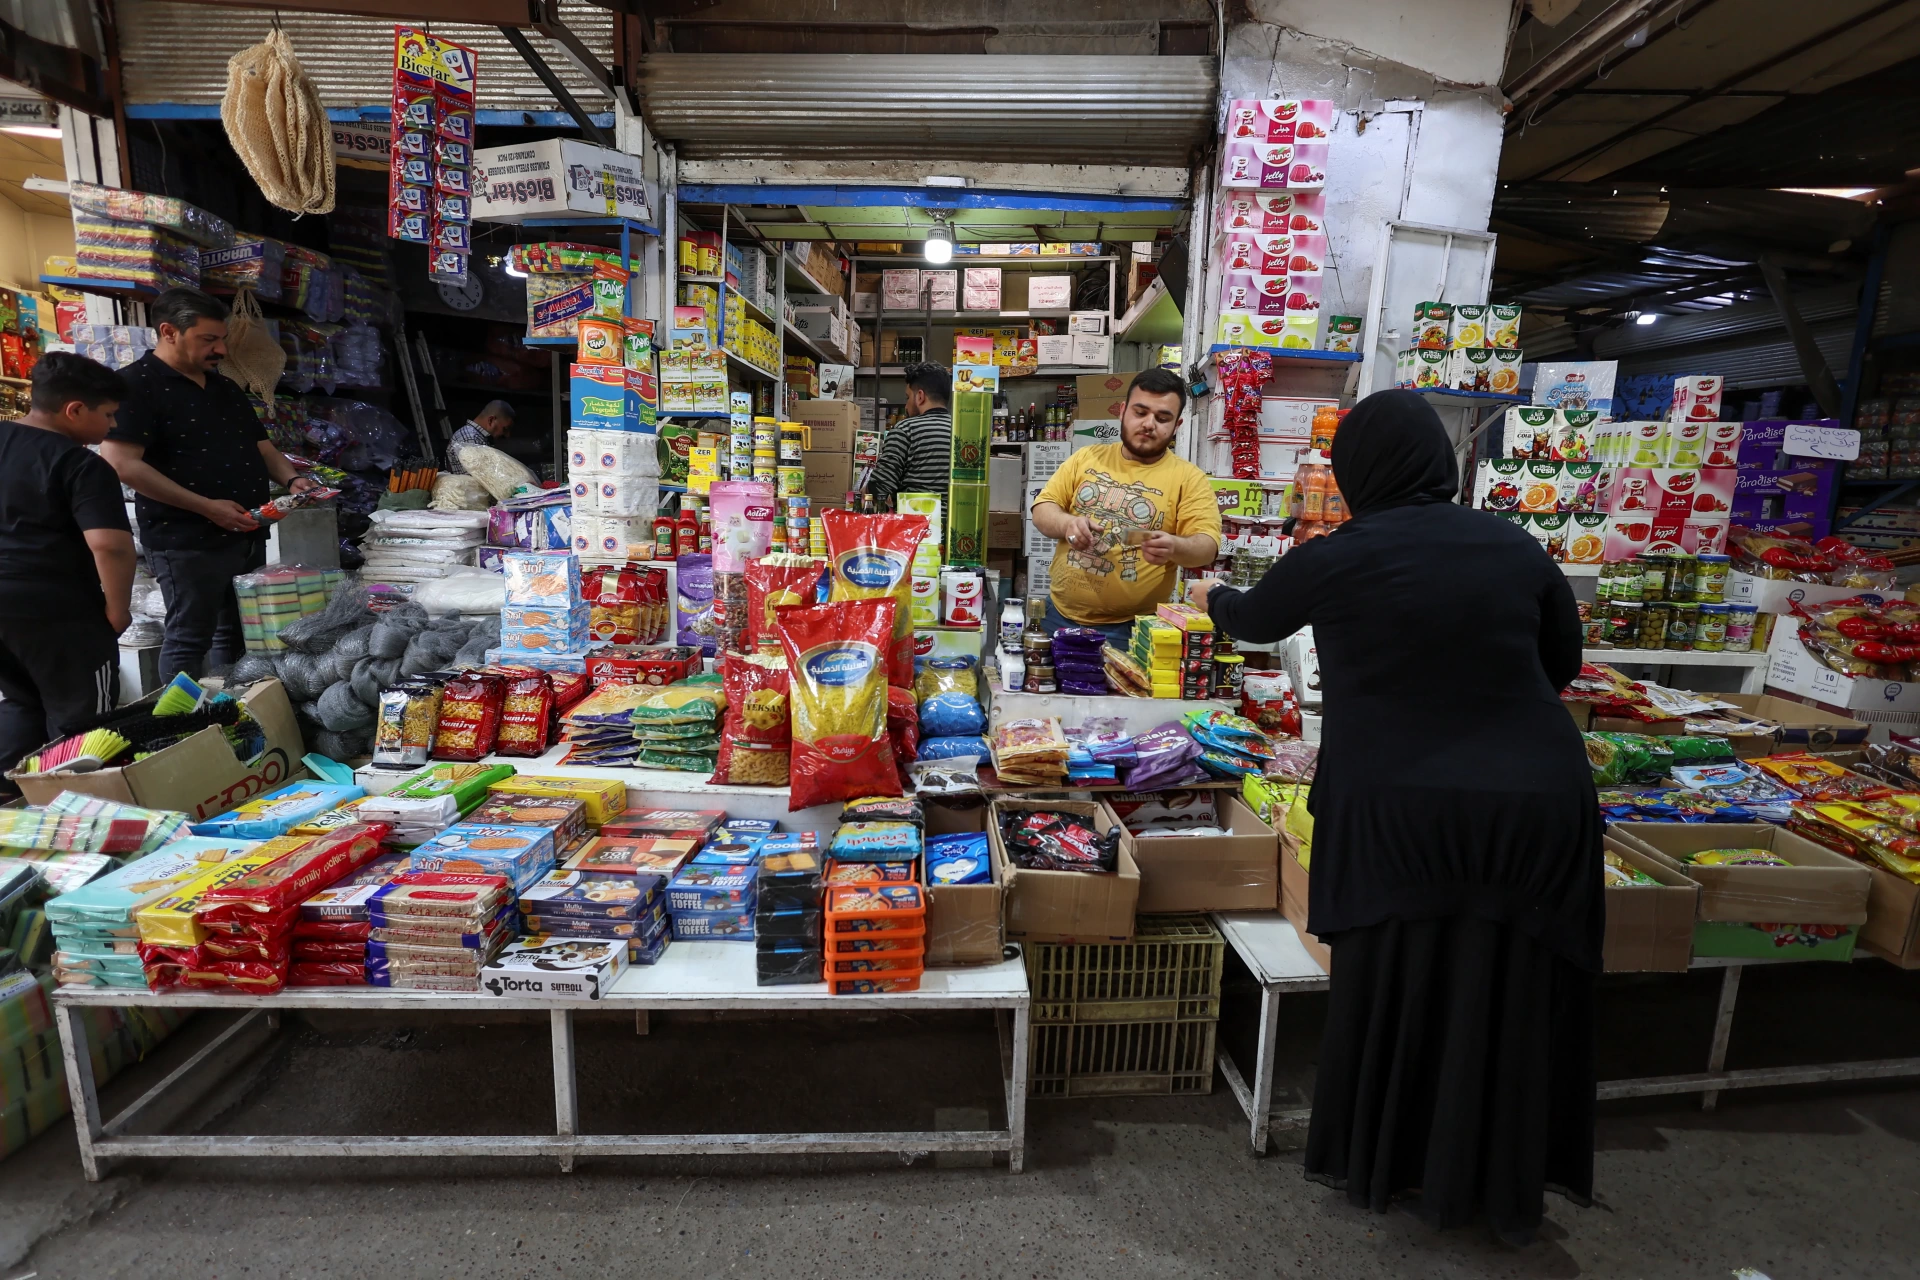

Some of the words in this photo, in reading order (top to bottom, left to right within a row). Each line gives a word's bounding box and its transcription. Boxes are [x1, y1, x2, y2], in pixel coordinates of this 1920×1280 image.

[401, 56, 450, 82] Bicstar
[1264, 170, 1285, 182] jelly
[1266, 257, 1286, 268] jelly
[598, 280, 624, 298] TANG
[1462, 308, 1480, 316] Fresh
[1497, 308, 1515, 317] Fresh
[1338, 323, 1354, 331] Fresh
[628, 335, 650, 350] TANG
[592, 406, 619, 414] Vegetable
[1741, 427, 1785, 442] Paradise
[1735, 474, 1778, 489] Paradise
[1667, 497, 1686, 508] جيلي
[1654, 526, 1678, 537] jelly
[811, 665, 840, 675] الذهبية
[842, 660, 868, 671] السنبلة
[440, 719, 477, 729] Samira
[502, 714, 536, 723] Samira
[294, 868, 321, 890] Family
[323, 852, 348, 873] cookies
[671, 892, 701, 900] COCONUT
[672, 900, 702, 909] TOFFEE
[320, 905, 352, 916] Mutlu
[678, 926, 710, 935] TOFFEE
[500, 977, 543, 992] Torta
[551, 983, 583, 992] SUTROLL
